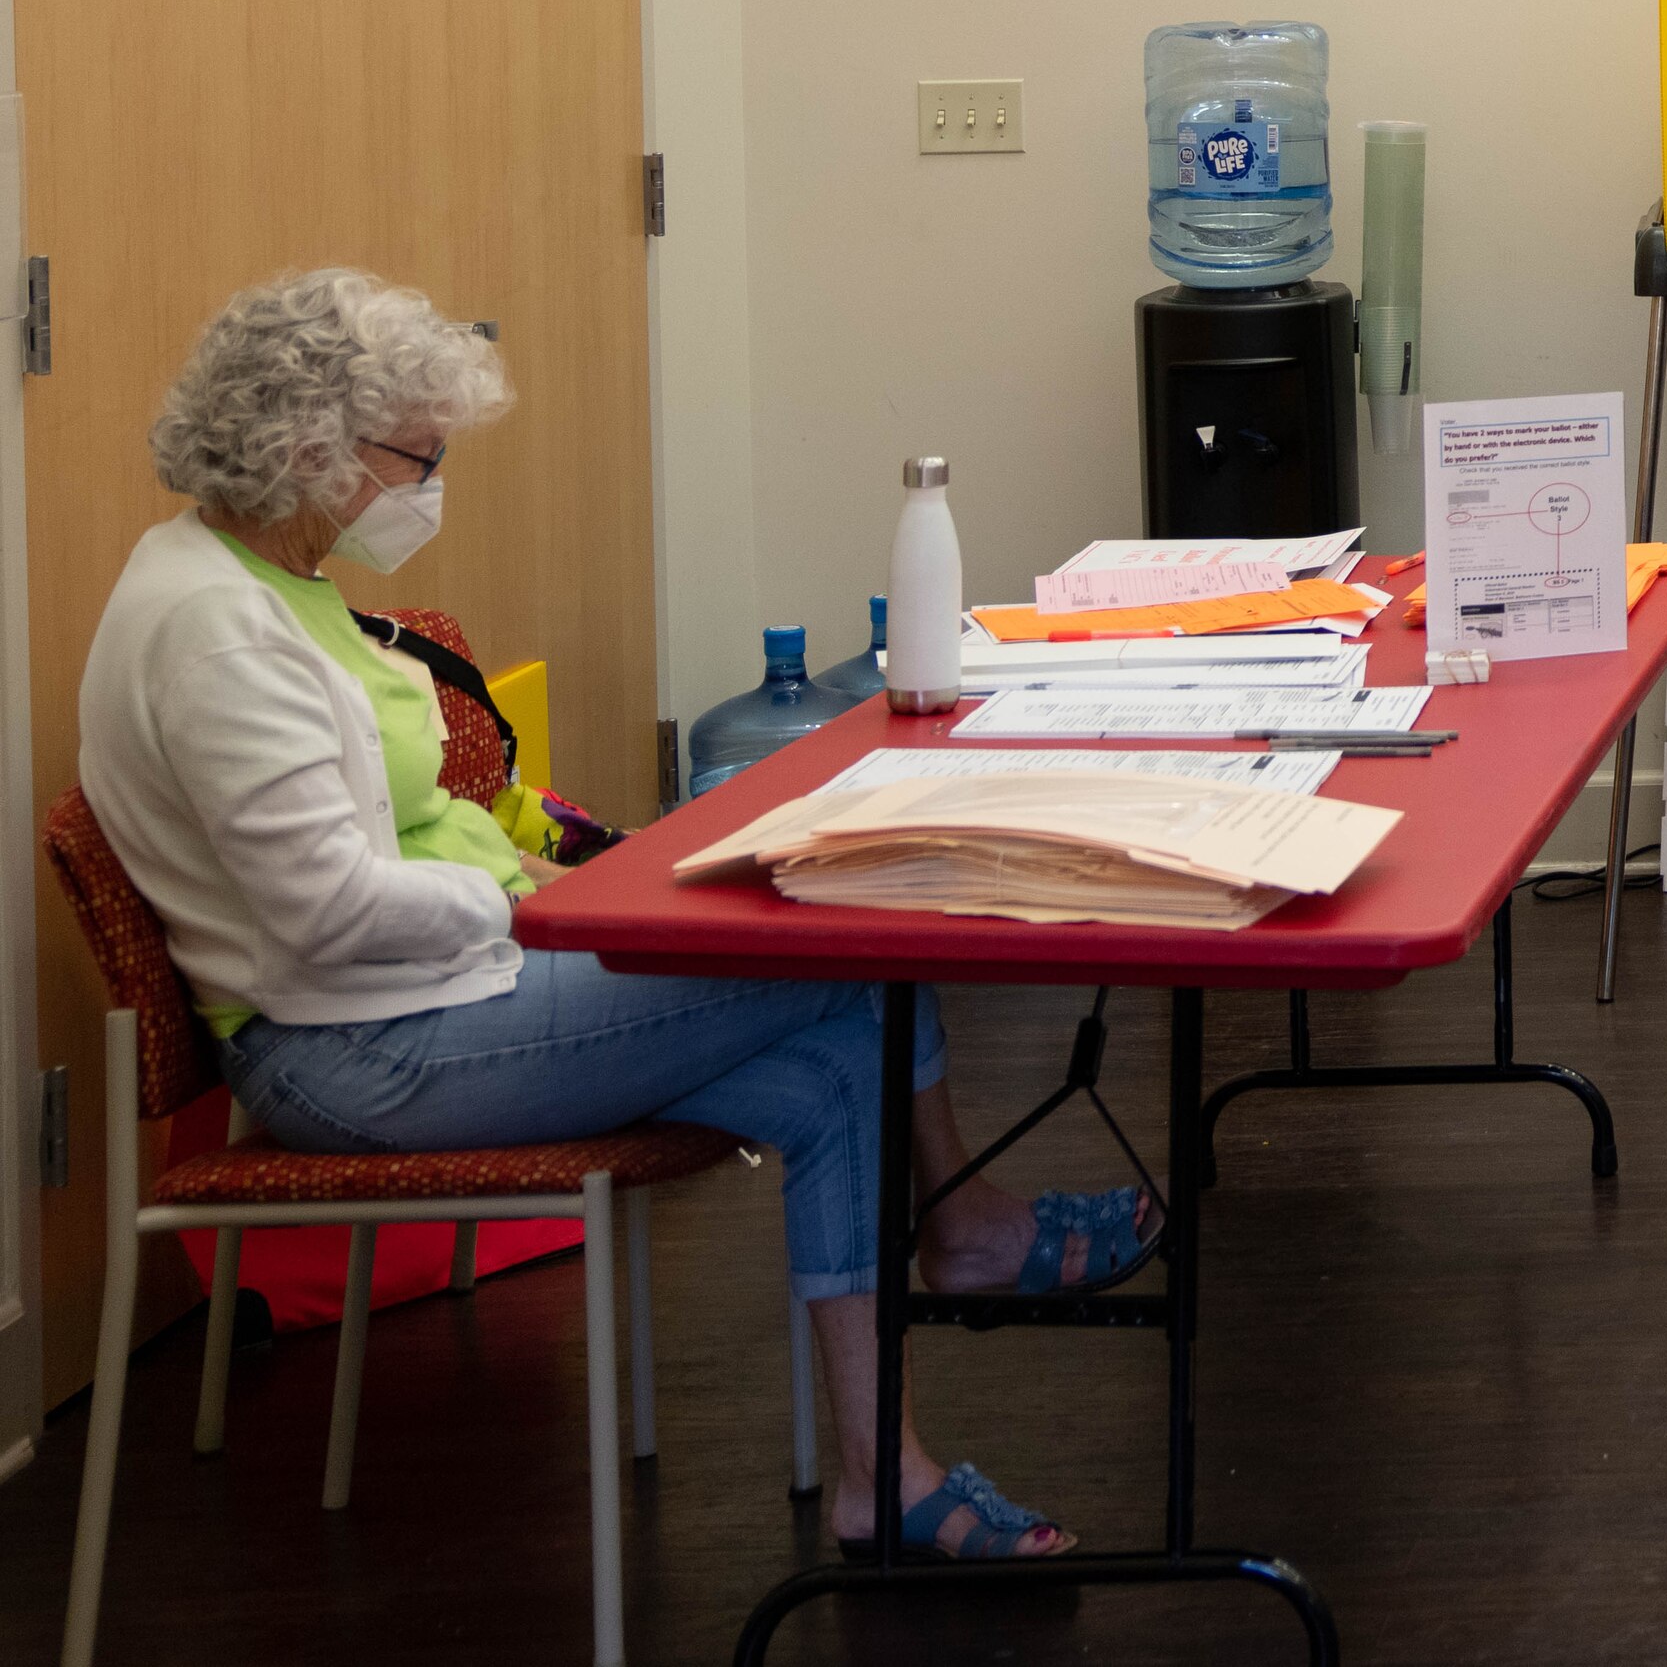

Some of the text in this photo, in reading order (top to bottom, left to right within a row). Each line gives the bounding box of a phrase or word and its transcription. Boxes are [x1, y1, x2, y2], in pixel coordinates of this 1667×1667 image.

[1551, 424, 1571, 432] ballot
[1454, 442, 1472, 450] hand
[1513, 438, 1547, 447] electronic
[1550, 505, 1568, 513] Style
